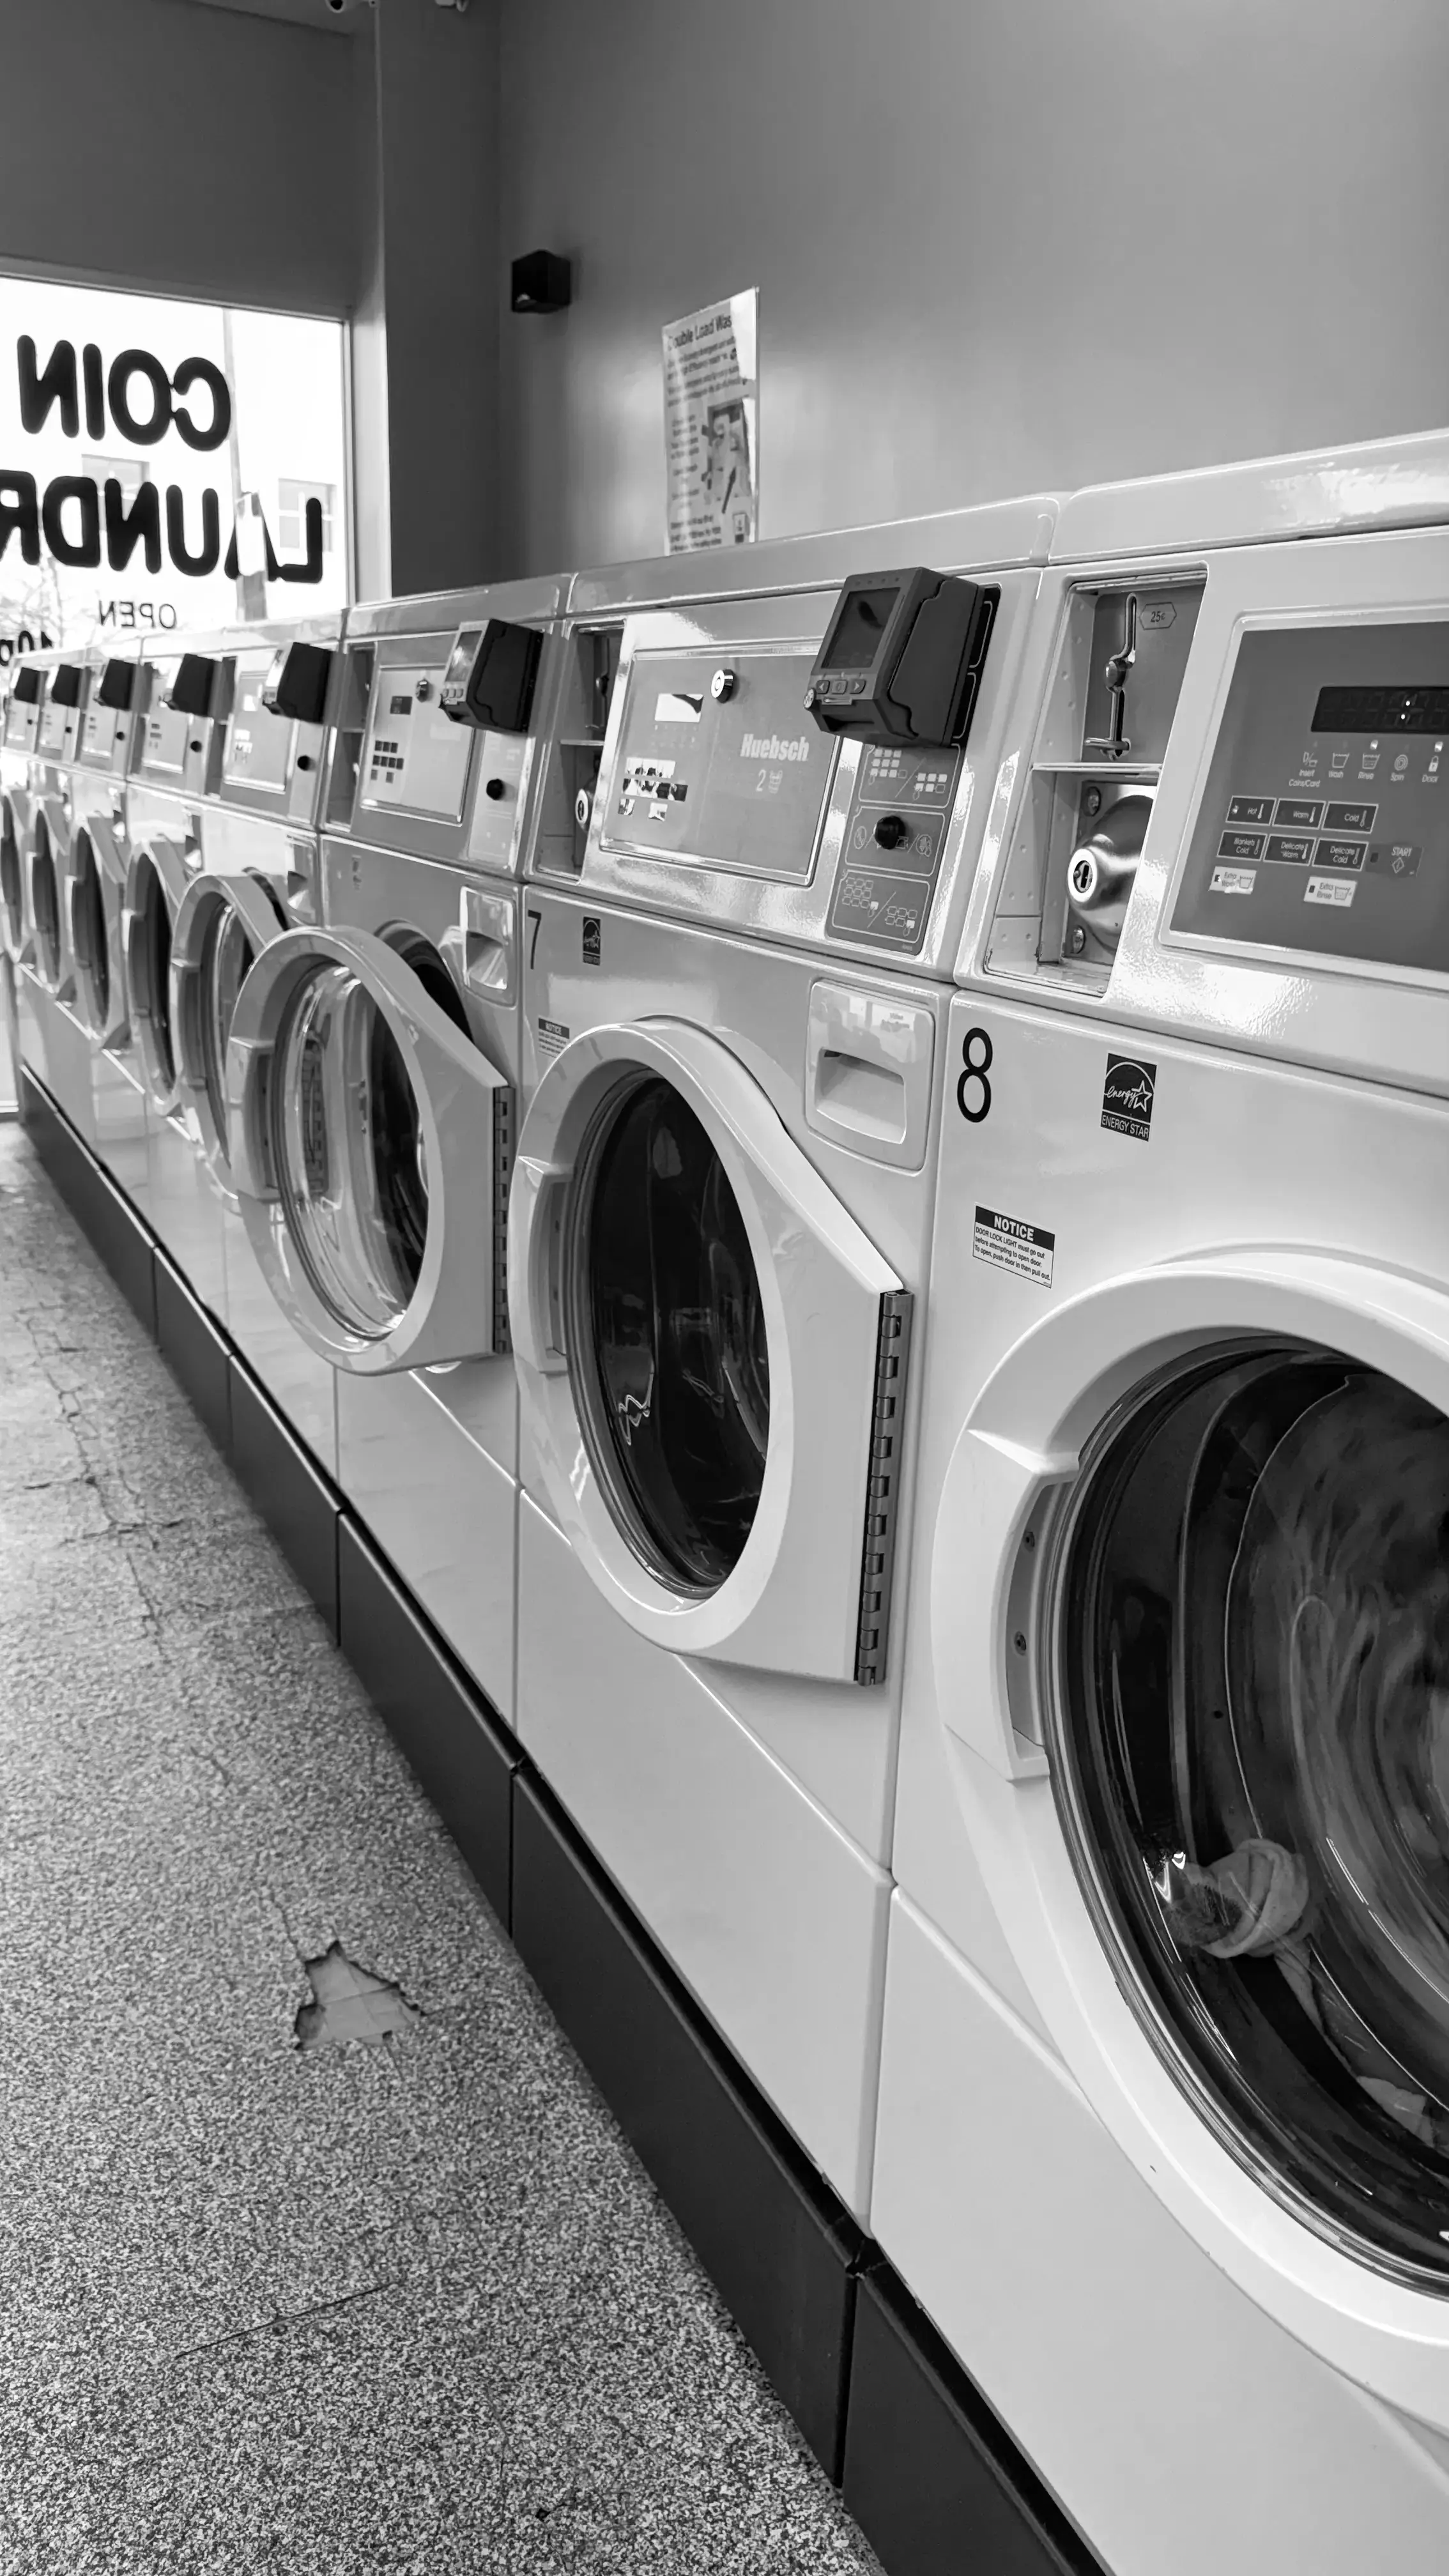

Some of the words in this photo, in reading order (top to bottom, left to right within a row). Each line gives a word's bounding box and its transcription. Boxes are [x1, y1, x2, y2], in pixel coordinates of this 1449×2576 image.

[669, 329, 693, 350] ouble
[695, 318, 714, 340] Load
[740, 733, 809, 762] Huebsch
[1358, 770, 1374, 780] Rinse
[1390, 772, 1405, 781] Spin
[1344, 813, 1360, 822] Cold
[1236, 846, 1250, 854] Cold
[1333, 855, 1349, 864] Cold
[1391, 847, 1413, 857] START
[528, 909, 542, 970] 7
[957, 1027, 993, 1123] 8
[1101, 1114, 1130, 1132] ENERGY
[1130, 1123, 1149, 1138] STAR
[976, 1226, 989, 1237] DOOR
[990, 1232, 1002, 1243] LOCK
[1003, 1238, 1017, 1248] LIGHT
[1018, 1244, 1029, 1252] must
[994, 1215, 1034, 1241] NOTICE
[974, 1244, 979, 1252] To
[993, 1253, 1004, 1262] push
[1004, 1257, 1015, 1266] door
[1020, 1263, 1031, 1273] then
[1031, 1268, 1041, 1276] pull
[975, 1236, 988, 1246] before
[989, 1242, 1012, 1257] attempting
[1018, 1254, 1030, 1262] open
